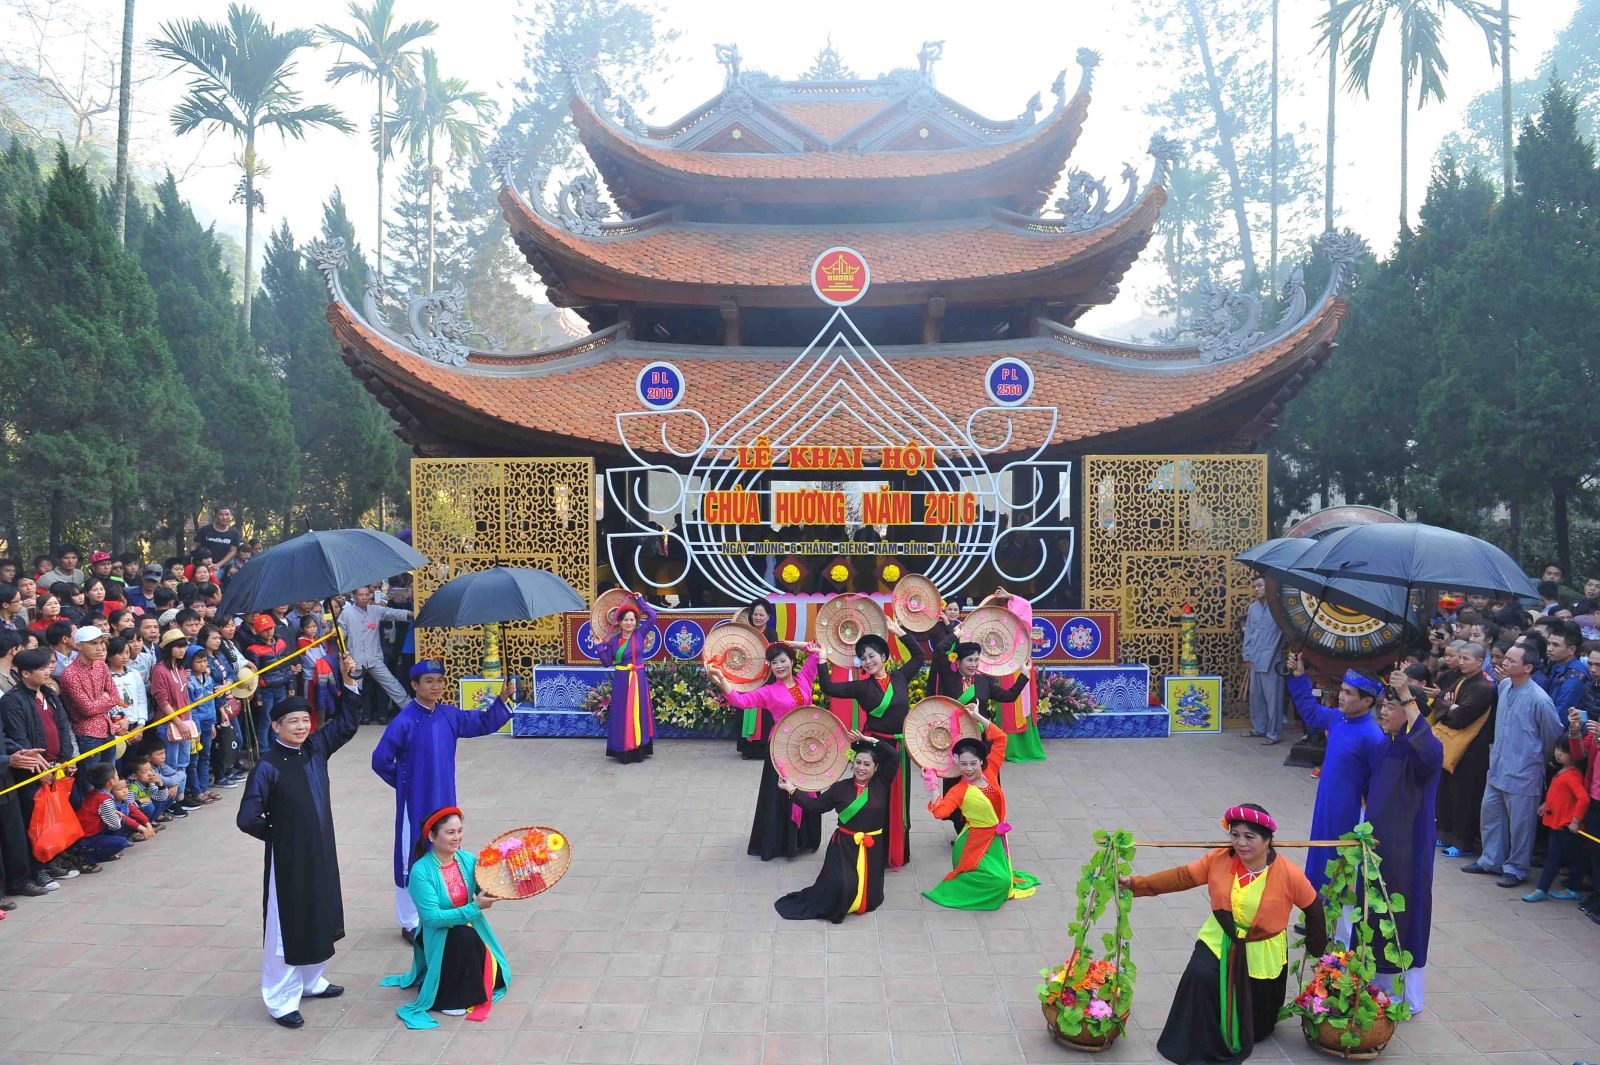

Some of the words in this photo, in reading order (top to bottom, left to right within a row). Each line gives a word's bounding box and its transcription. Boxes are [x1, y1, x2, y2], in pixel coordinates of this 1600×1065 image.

[647, 388, 673, 399] 2016
[997, 384, 1022, 395] 2560
[737, 435, 772, 469] LỄ
[788, 446, 864, 470] KHAI
[881, 442, 937, 475] HỘI
[704, 484, 760, 525] CHÙA
[775, 490, 846, 525] HƯƠNG
[862, 484, 911, 525] NĂM
[924, 492, 976, 525] 2016
[722, 540, 749, 554] NGÀY
[755, 540, 785, 554] MÙNG
[789, 542, 797, 554] 6
[800, 540, 833, 554] THÁNG
[839, 540, 868, 555] GIÊNG
[874, 540, 898, 555] NĂM
[903, 540, 928, 555] BÍNH
[933, 541, 960, 555] THÂN
